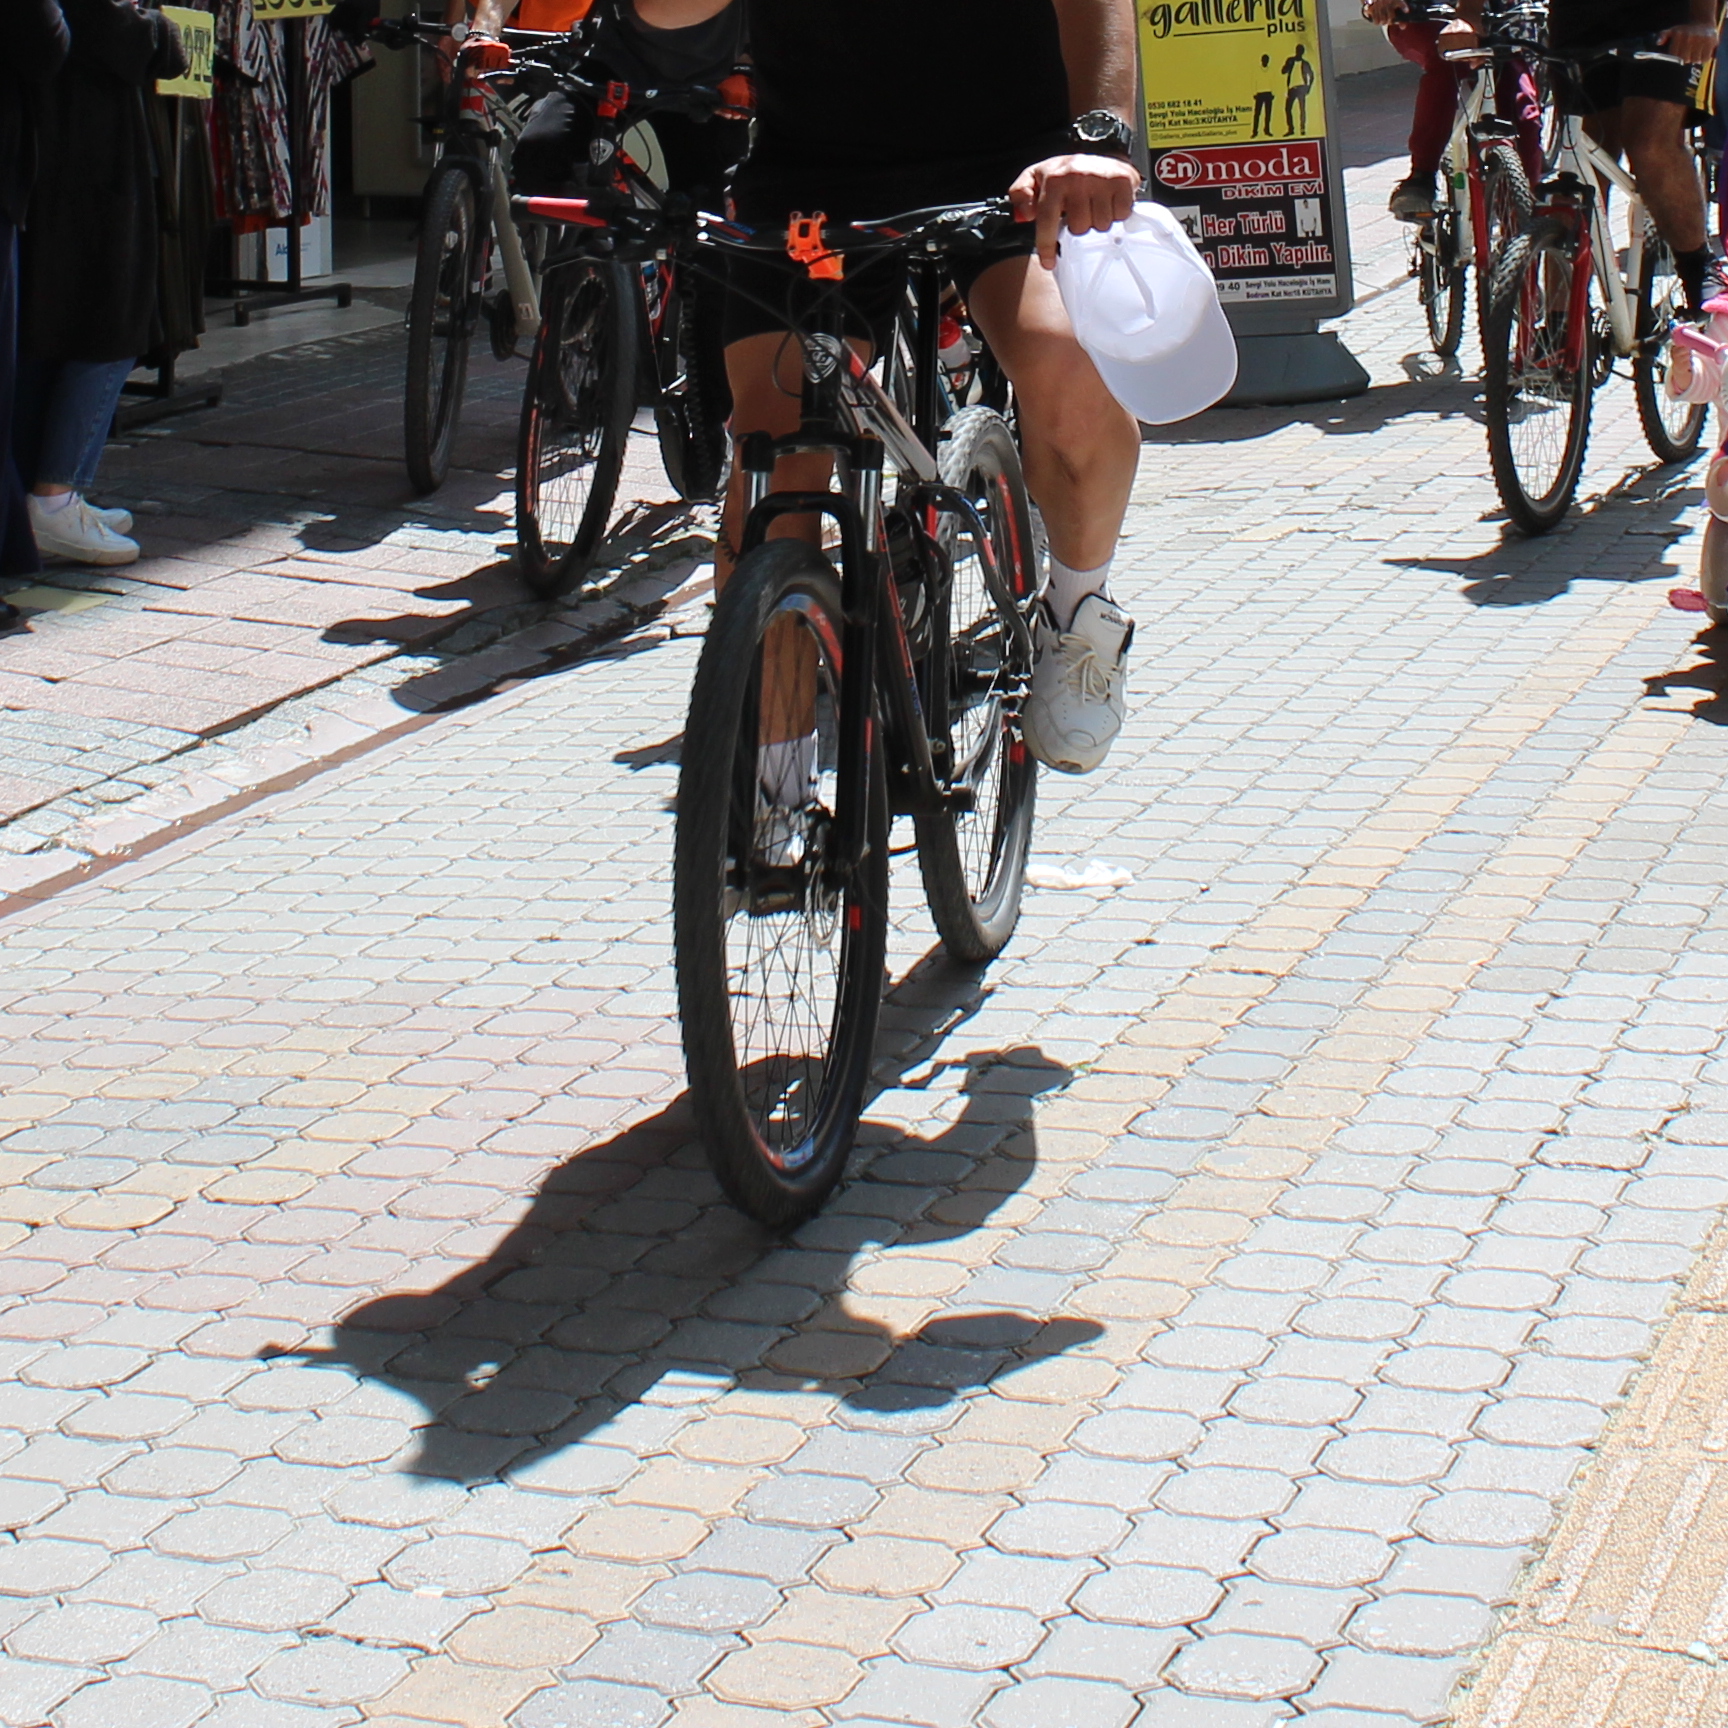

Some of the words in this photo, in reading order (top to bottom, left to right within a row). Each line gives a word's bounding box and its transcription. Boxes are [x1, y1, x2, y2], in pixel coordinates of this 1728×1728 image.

[1266, 18, 1307, 37] plus
[1205, 146, 1314, 182] moda
[1222, 183, 1283, 200] DİKİM
[1288, 180, 1325, 197] EVİ
[1202, 216, 1235, 238] Her
[1237, 209, 1287, 236] Türlü
[1218, 246, 1270, 268] Dikim
[1271, 242, 1332, 270] Yapılır.
